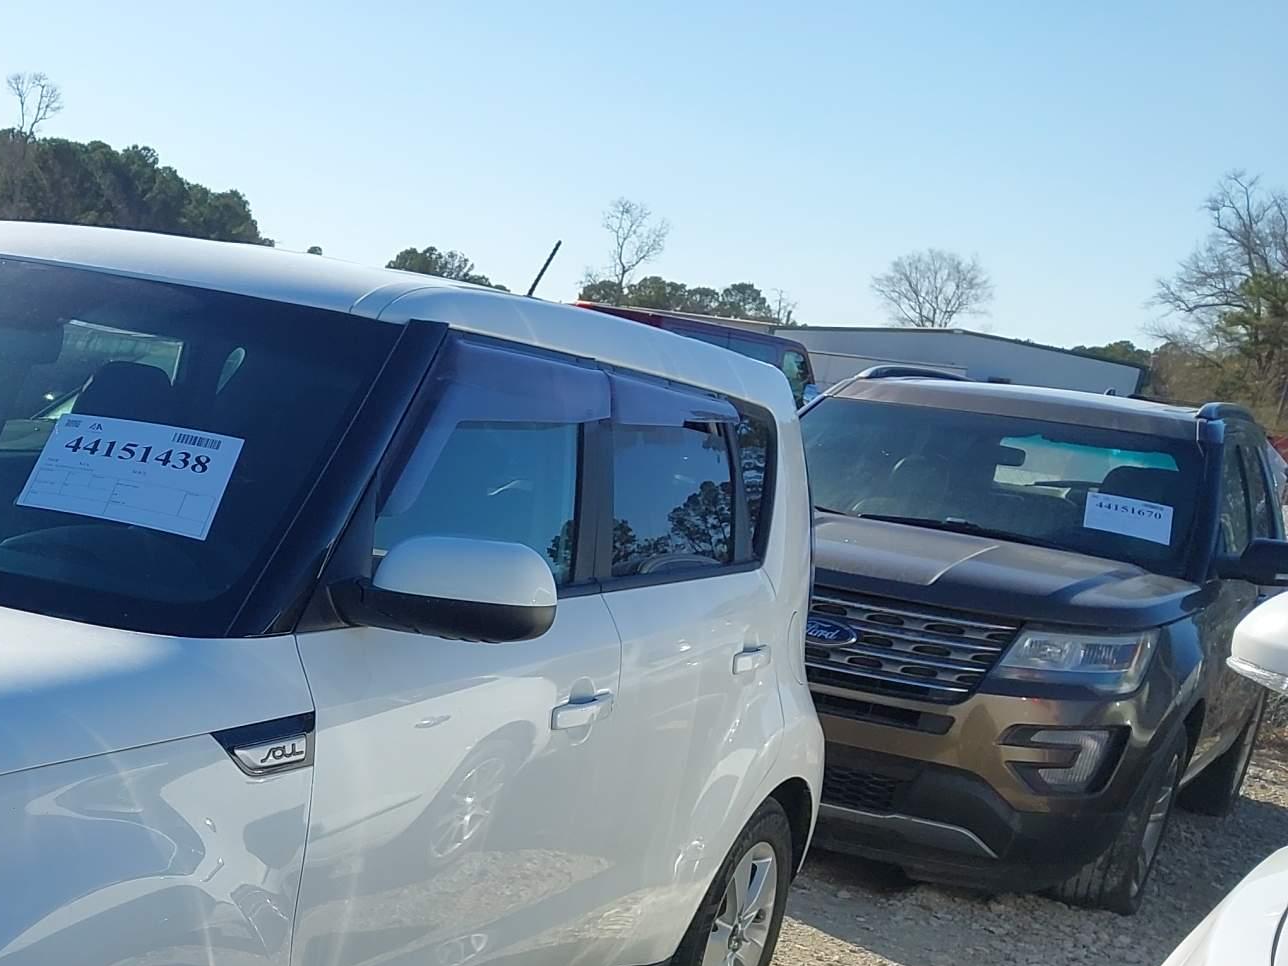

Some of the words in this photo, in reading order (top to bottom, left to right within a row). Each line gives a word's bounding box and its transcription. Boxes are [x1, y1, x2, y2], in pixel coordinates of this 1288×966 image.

[65, 436, 211, 474] 44151438
[1096, 501, 1163, 520] 44151670
[260, 743, 305, 764] SOUL
